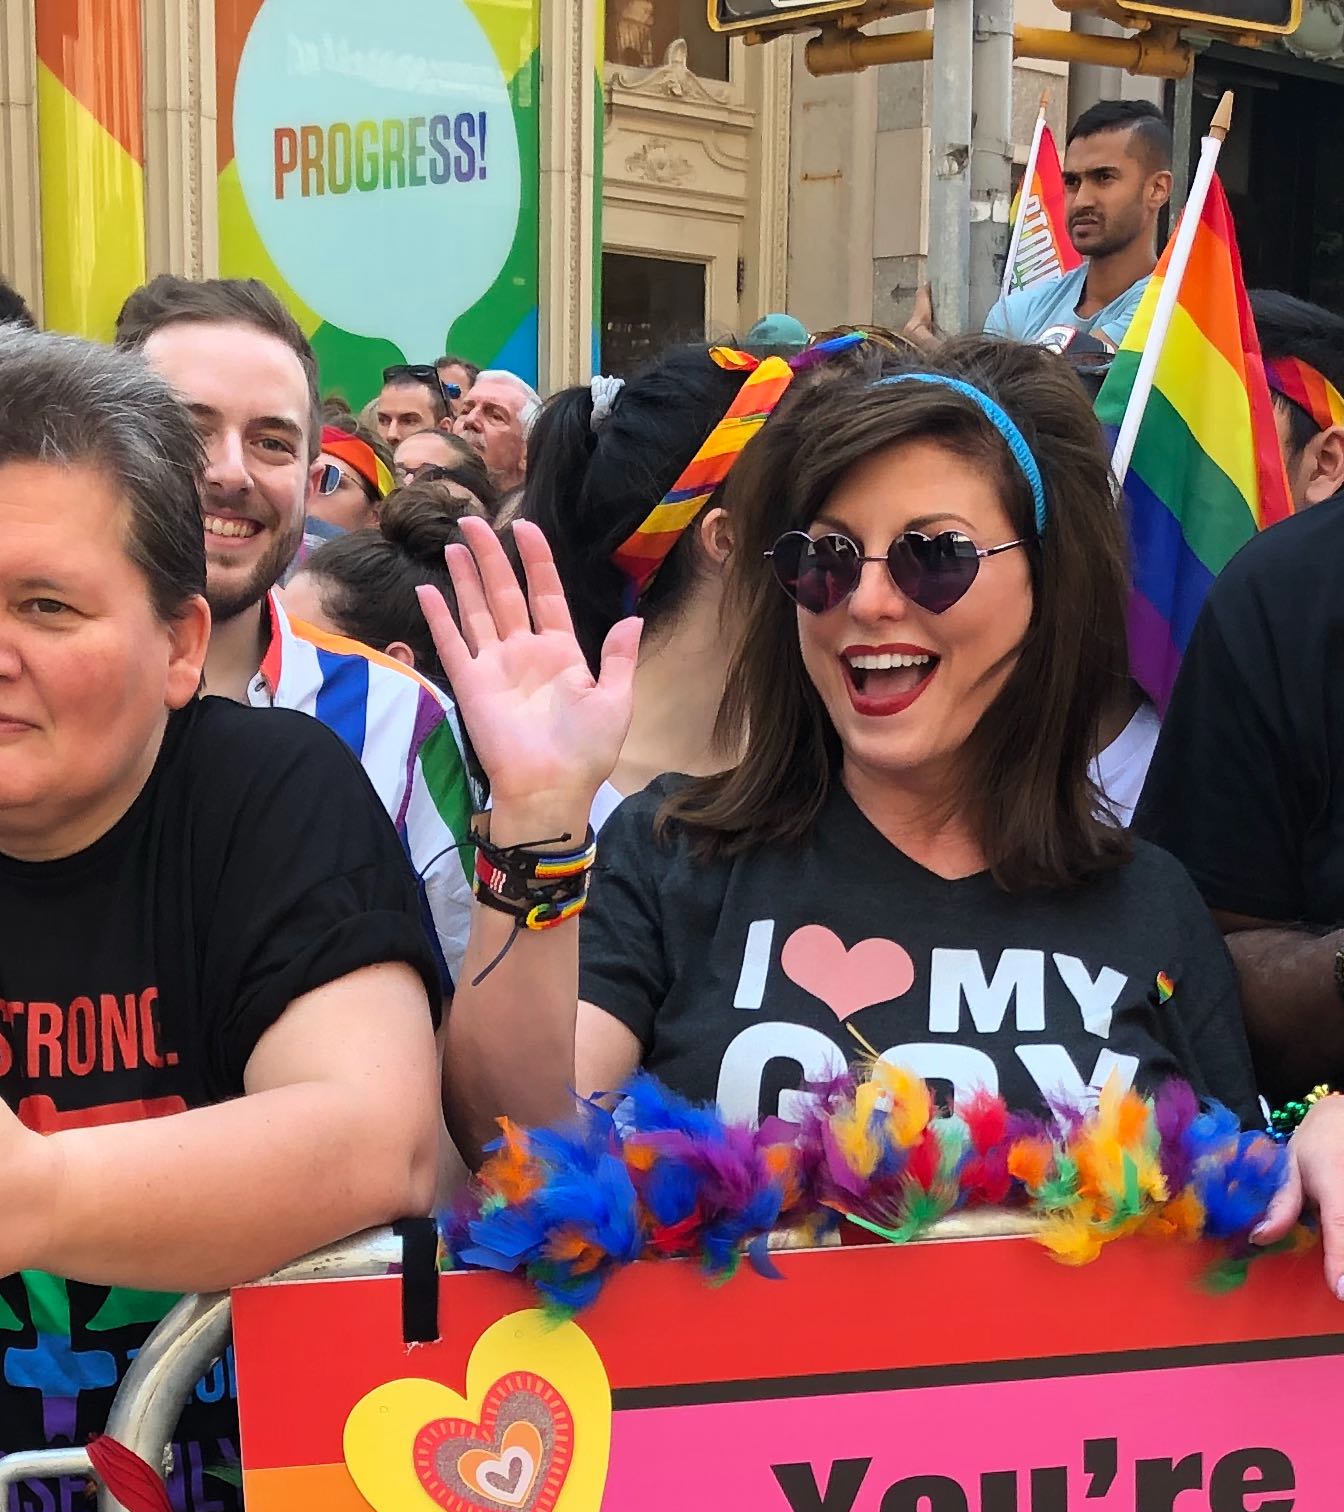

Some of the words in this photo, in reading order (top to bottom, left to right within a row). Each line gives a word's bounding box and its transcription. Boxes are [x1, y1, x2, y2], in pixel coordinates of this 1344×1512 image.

[273, 110, 487, 200] PROGRESS!
[732, 919, 775, 1010] I
[928, 946, 1129, 1040] MY
